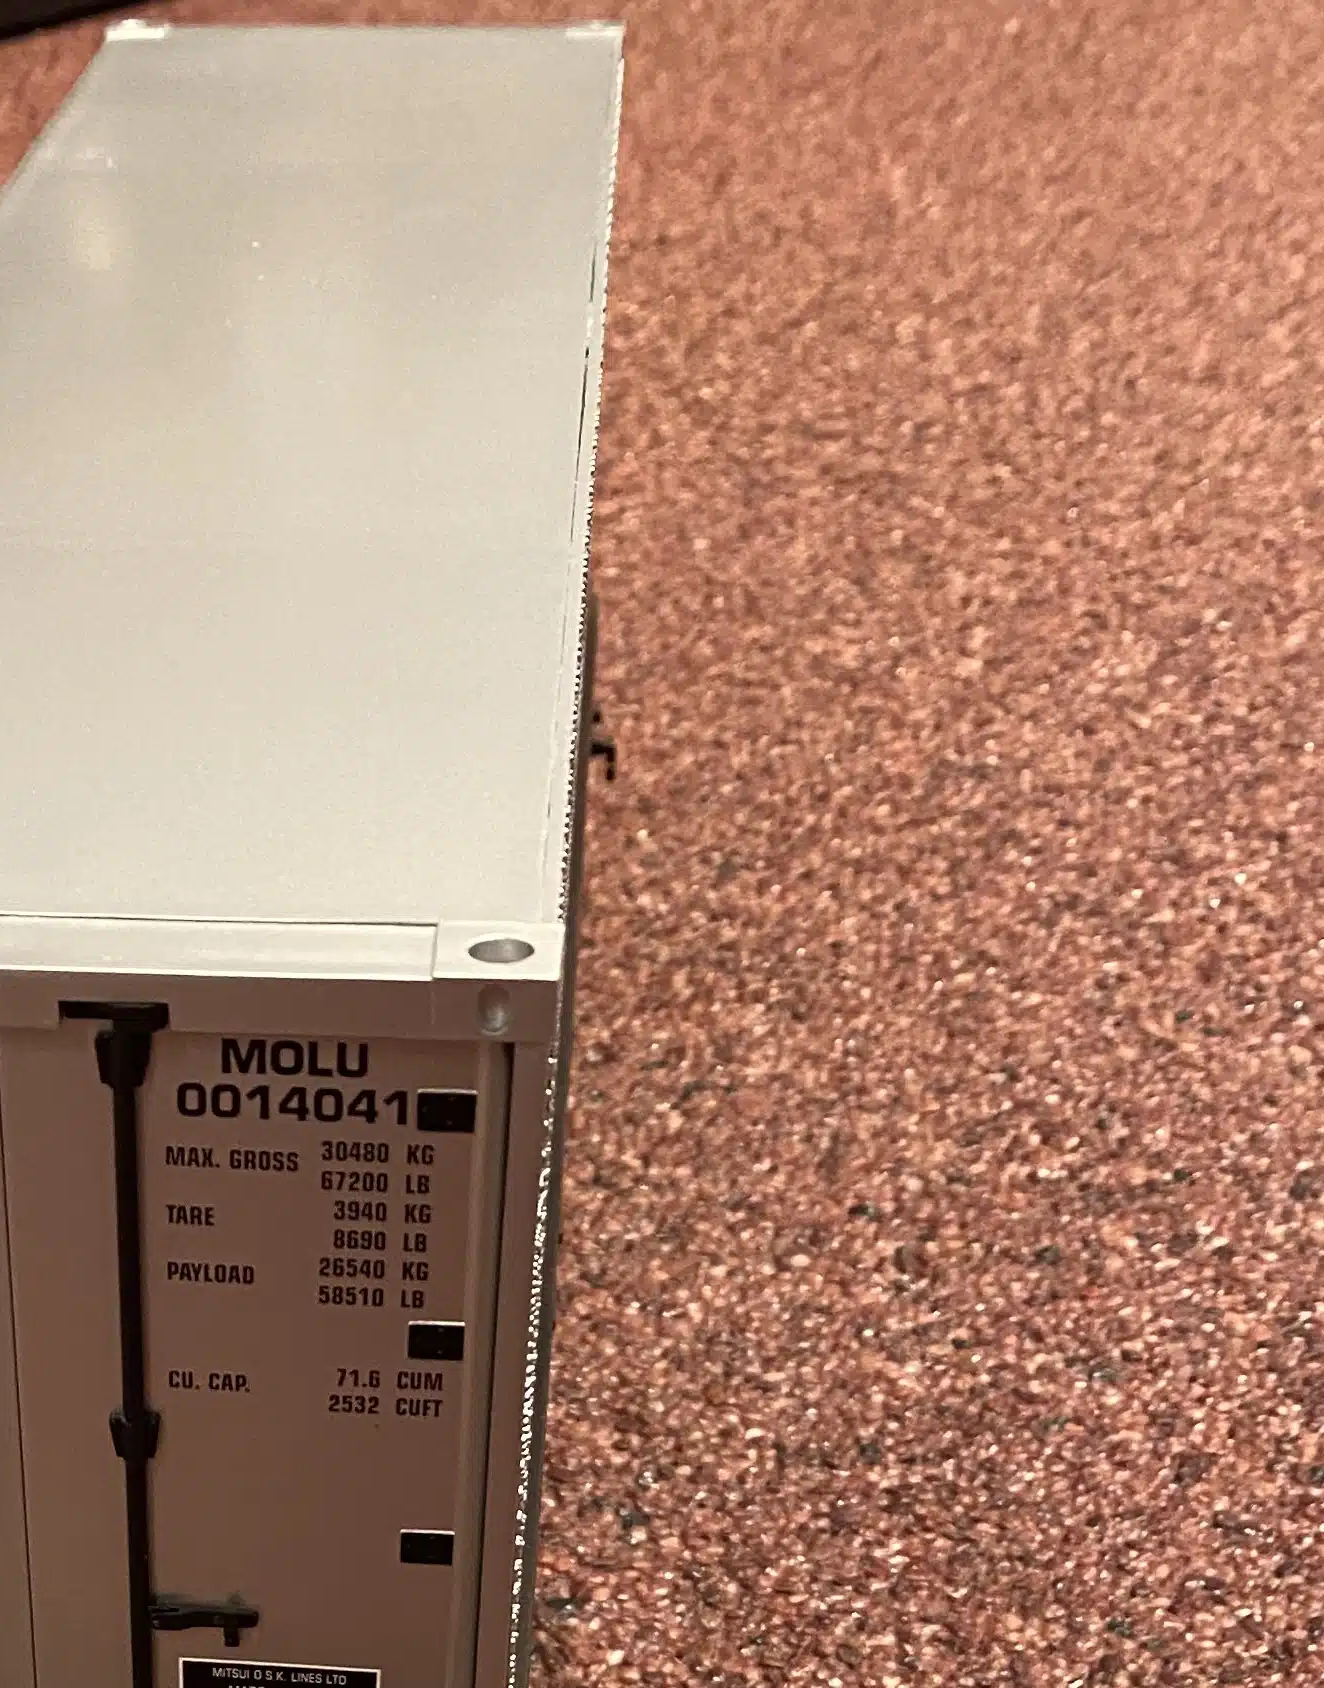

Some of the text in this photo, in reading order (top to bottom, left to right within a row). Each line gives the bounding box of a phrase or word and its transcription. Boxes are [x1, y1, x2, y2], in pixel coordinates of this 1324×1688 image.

[221, 1038, 369, 1077] MOLU
[176, 1082, 408, 1126] 0014041
[165, 1140, 435, 1172] MAX. GROSS 30480 KG
[321, 1171, 430, 1195] 67200 LB
[166, 1200, 432, 1226] TARE 3940 KG
[333, 1229, 427, 1253] 8690 LB
[167, 1258, 429, 1285] PAYLOAD 26540 KG
[318, 1285, 425, 1309] 58510 LB
[168, 1368, 443, 1393] CU. CAP. 71.6 CUM
[328, 1394, 443, 1418] 2532 CUFT
[212, 1667, 250, 1679] MITSUI
[291, 1672, 322, 1684] LINES
[326, 1674, 347, 1685] LTD
